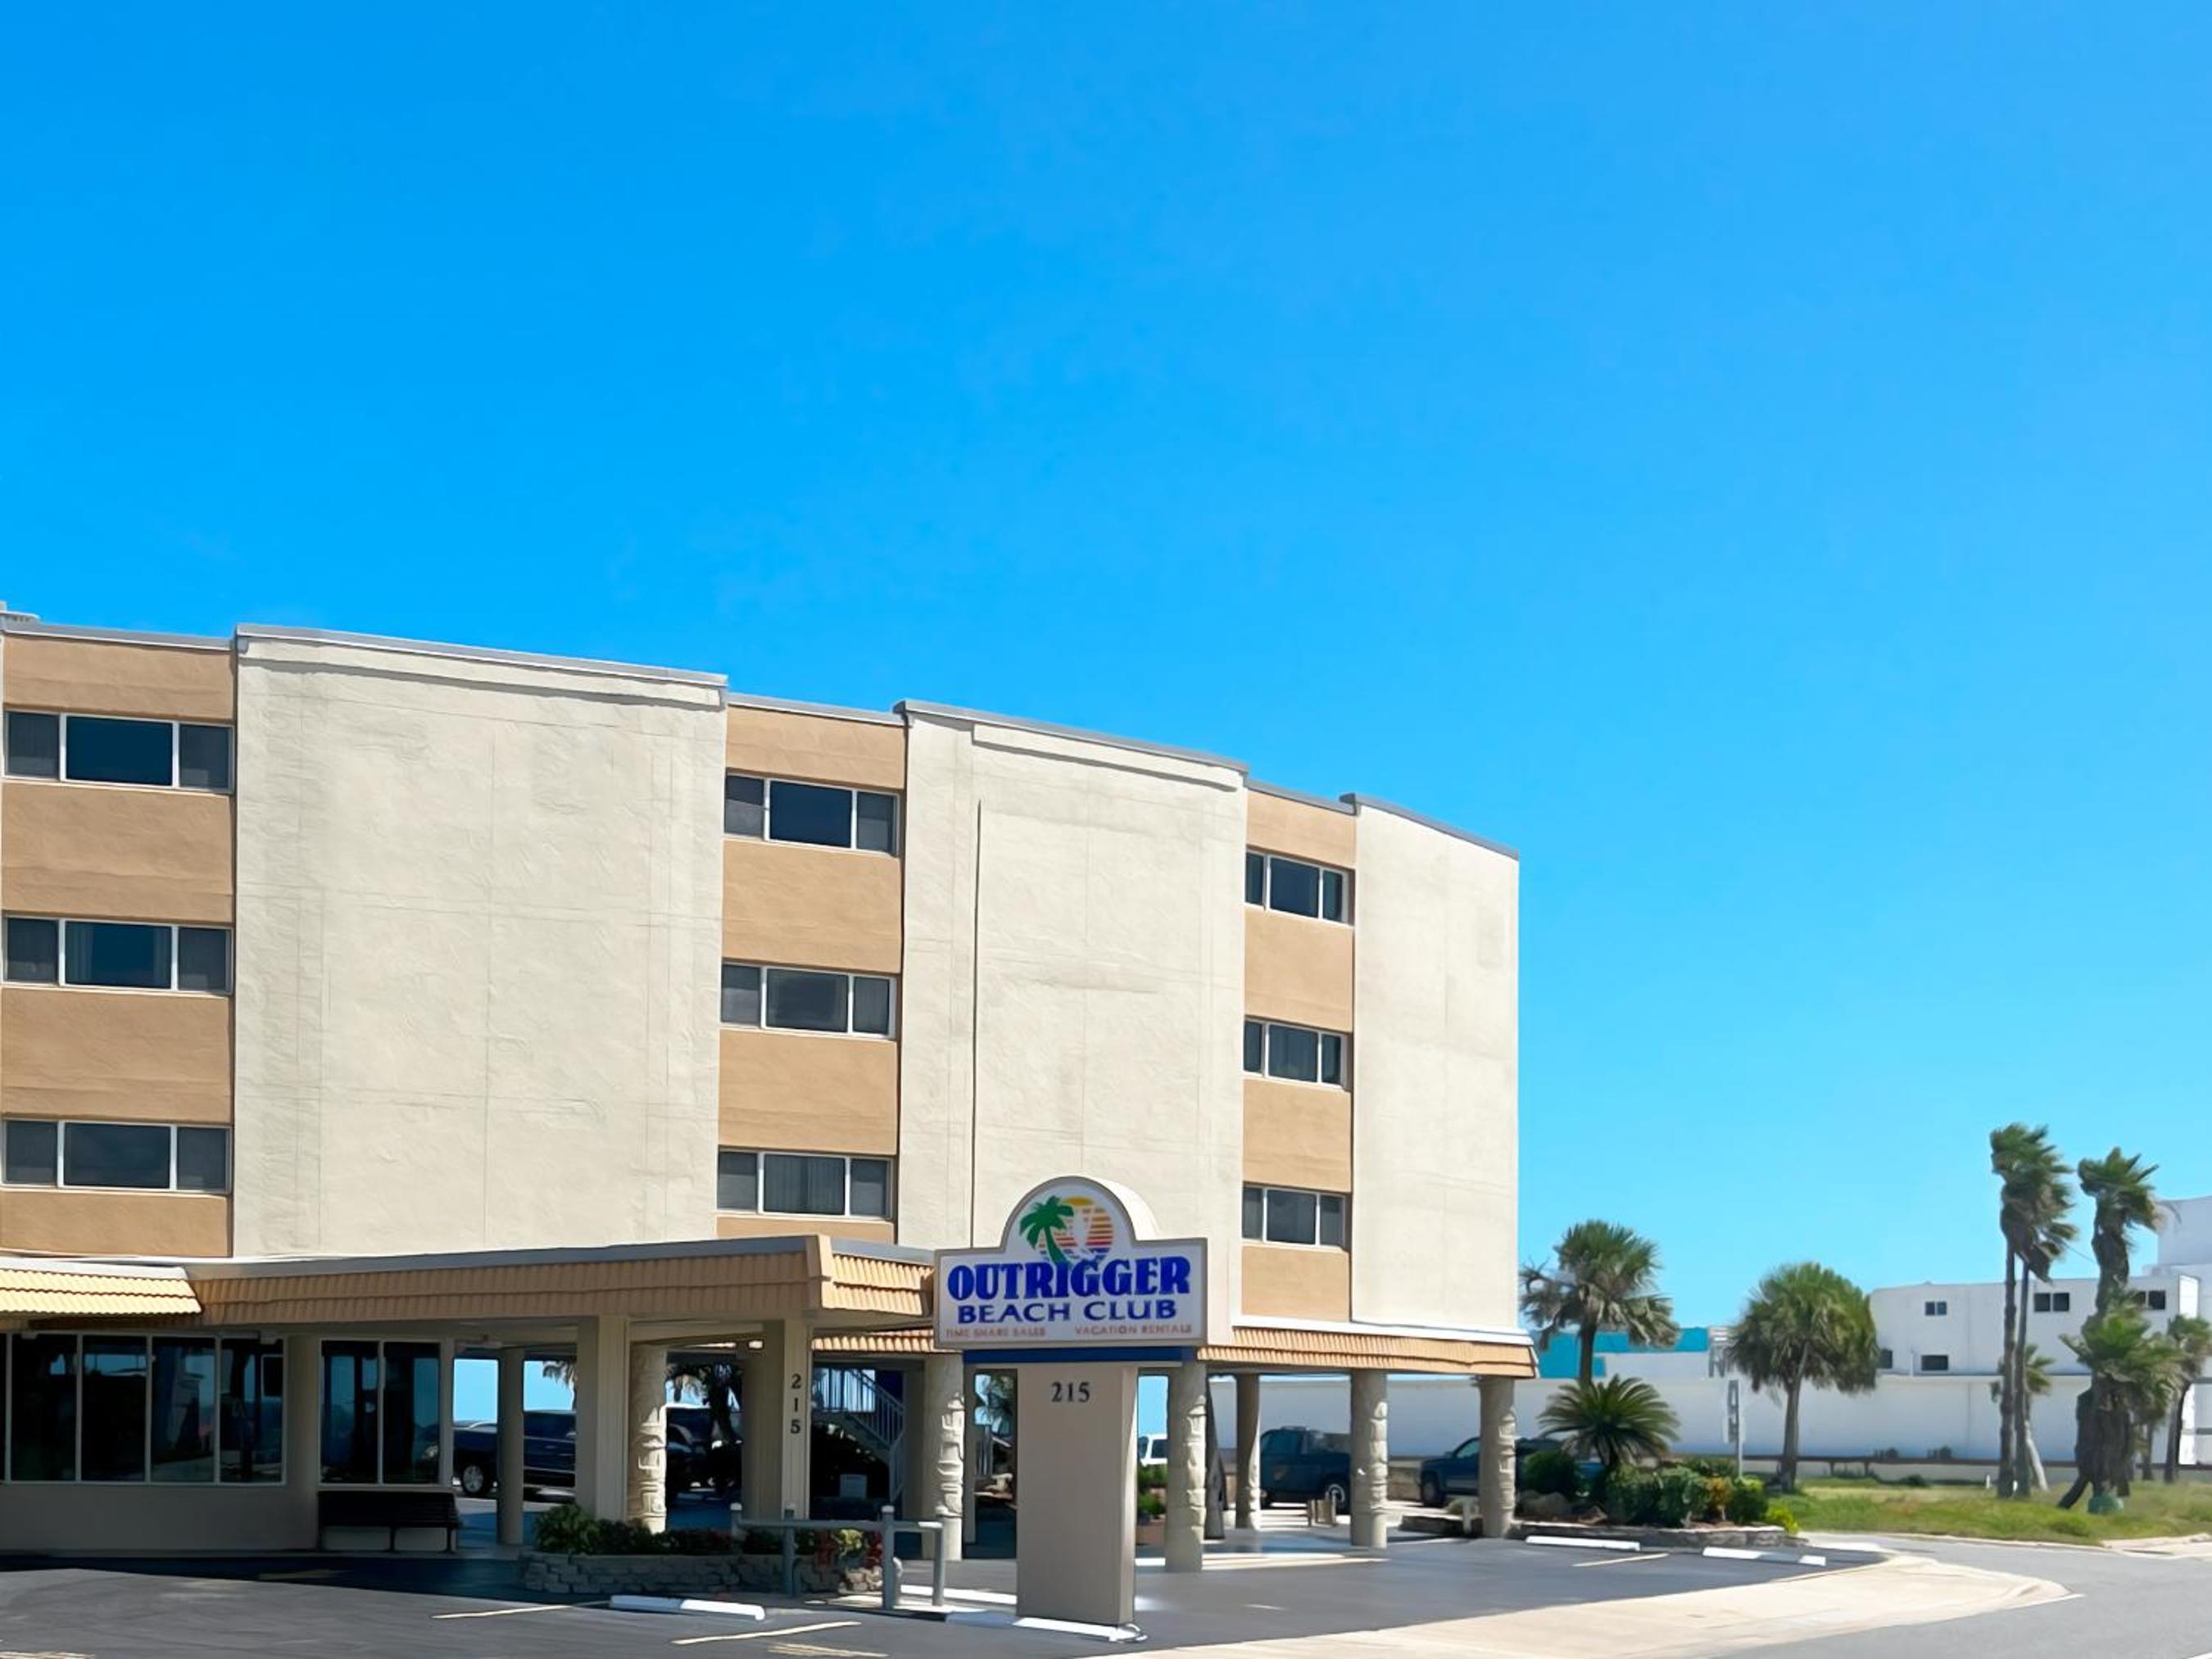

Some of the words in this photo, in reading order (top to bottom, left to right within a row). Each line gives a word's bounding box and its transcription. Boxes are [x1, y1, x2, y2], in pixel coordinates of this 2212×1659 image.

[947, 1256, 1191, 1301] OUTRIGGER
[957, 1303, 1072, 1324] BEACH
[1083, 1299, 1177, 1321] CLUB
[1075, 1325, 1138, 1335] VACATION
[790, 1372, 802, 1435] 215
[1051, 1381, 1090, 1403] 215
